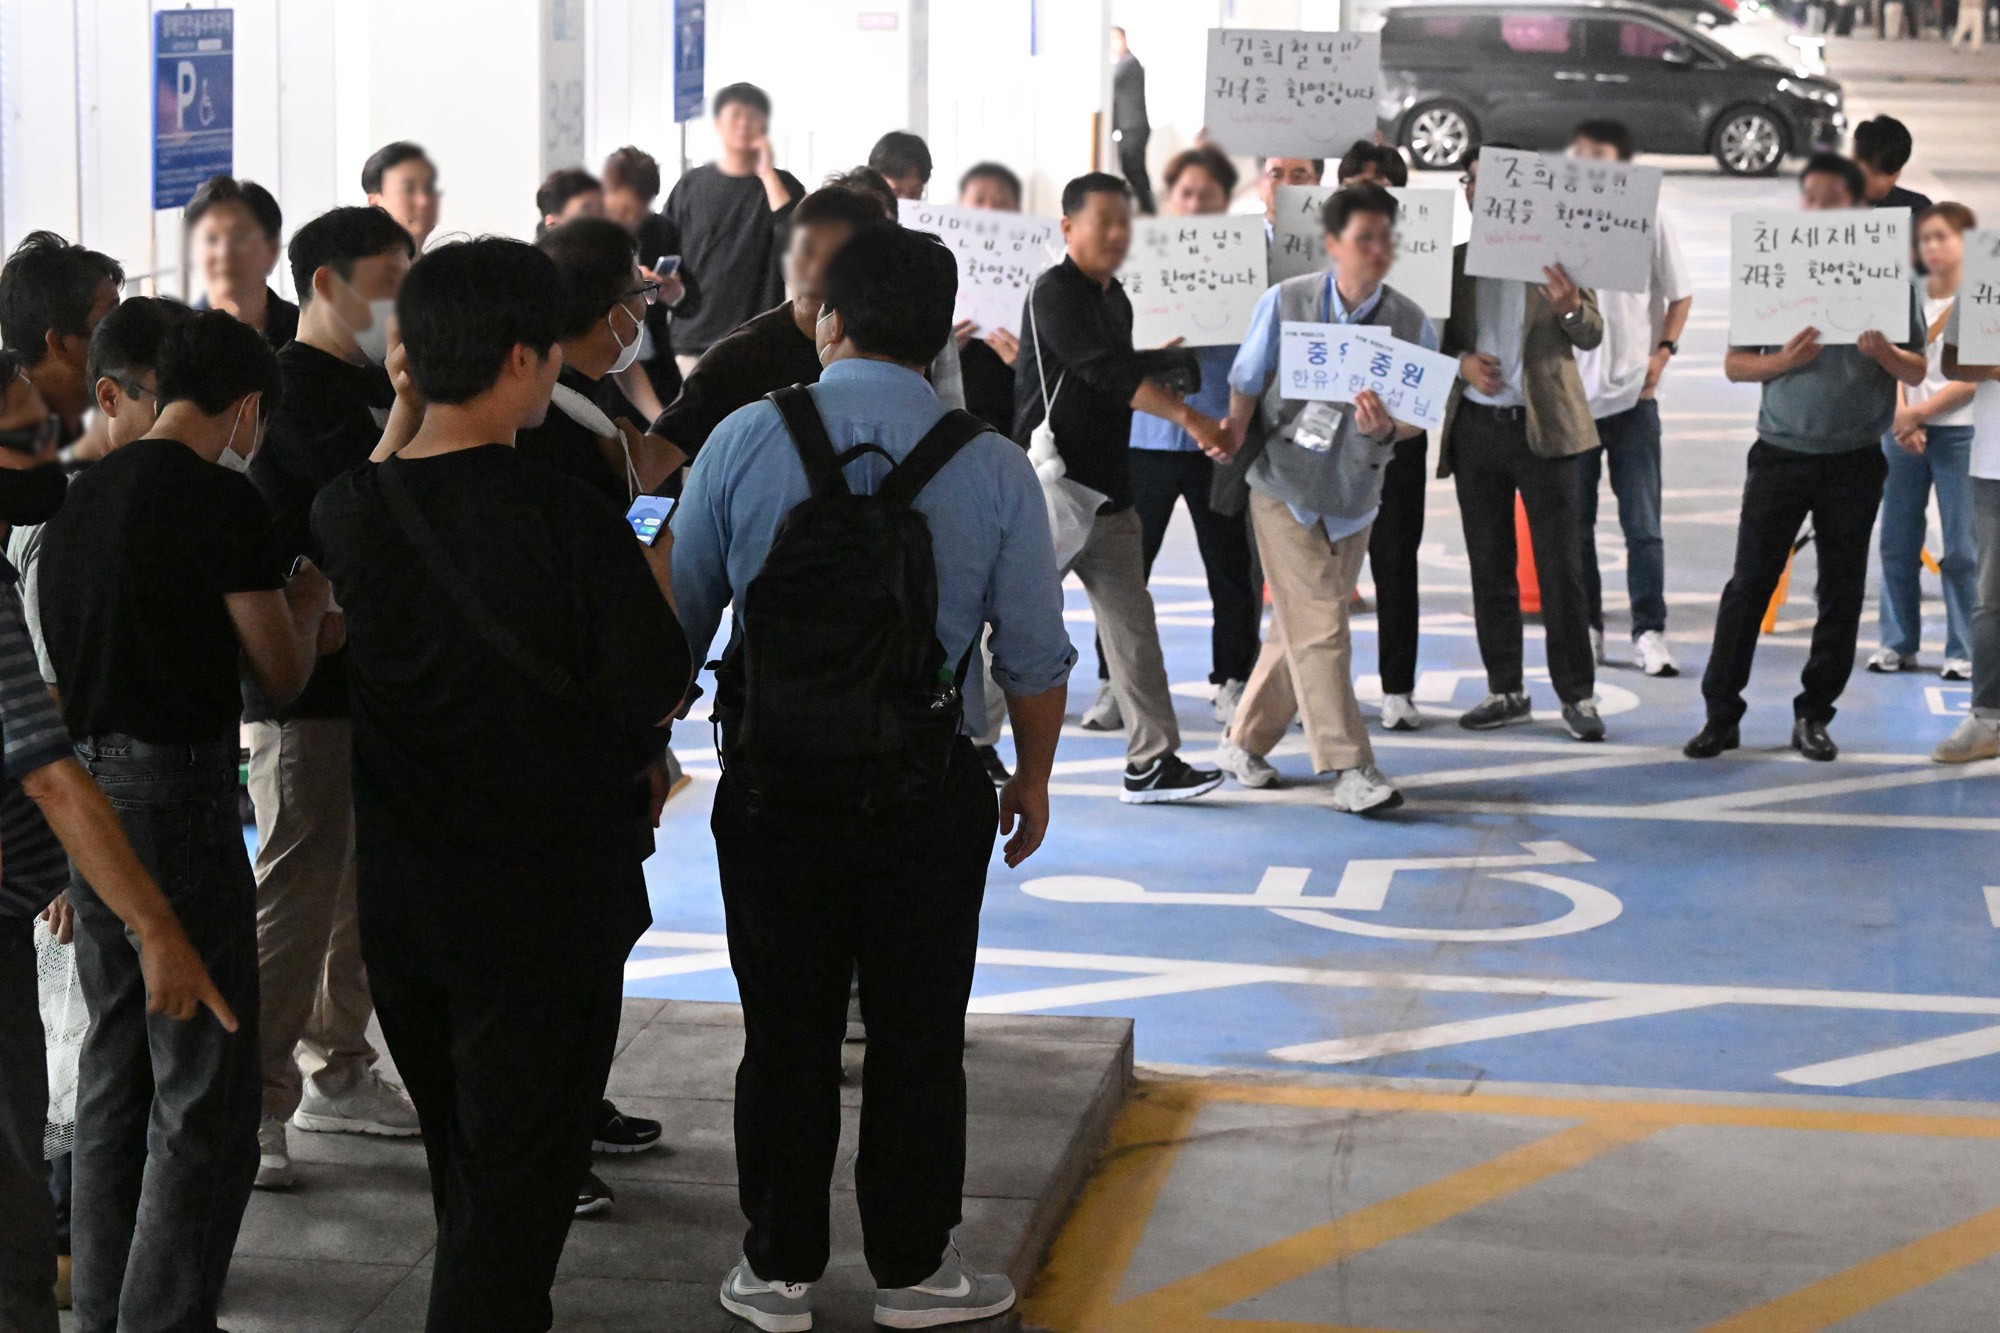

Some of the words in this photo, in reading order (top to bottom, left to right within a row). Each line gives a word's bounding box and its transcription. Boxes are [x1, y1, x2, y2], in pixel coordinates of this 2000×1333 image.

[177, 61, 197, 128] P
[1215, 76, 1268, 105] 귀국을
[1286, 77, 1374, 107] 환영합니다
[1484, 196, 1534, 225] 귀국을
[1556, 201, 1650, 234] 환영합니다
[1808, 259, 1901, 286] 환영합니다
[1292, 369, 1339, 391] 한유
